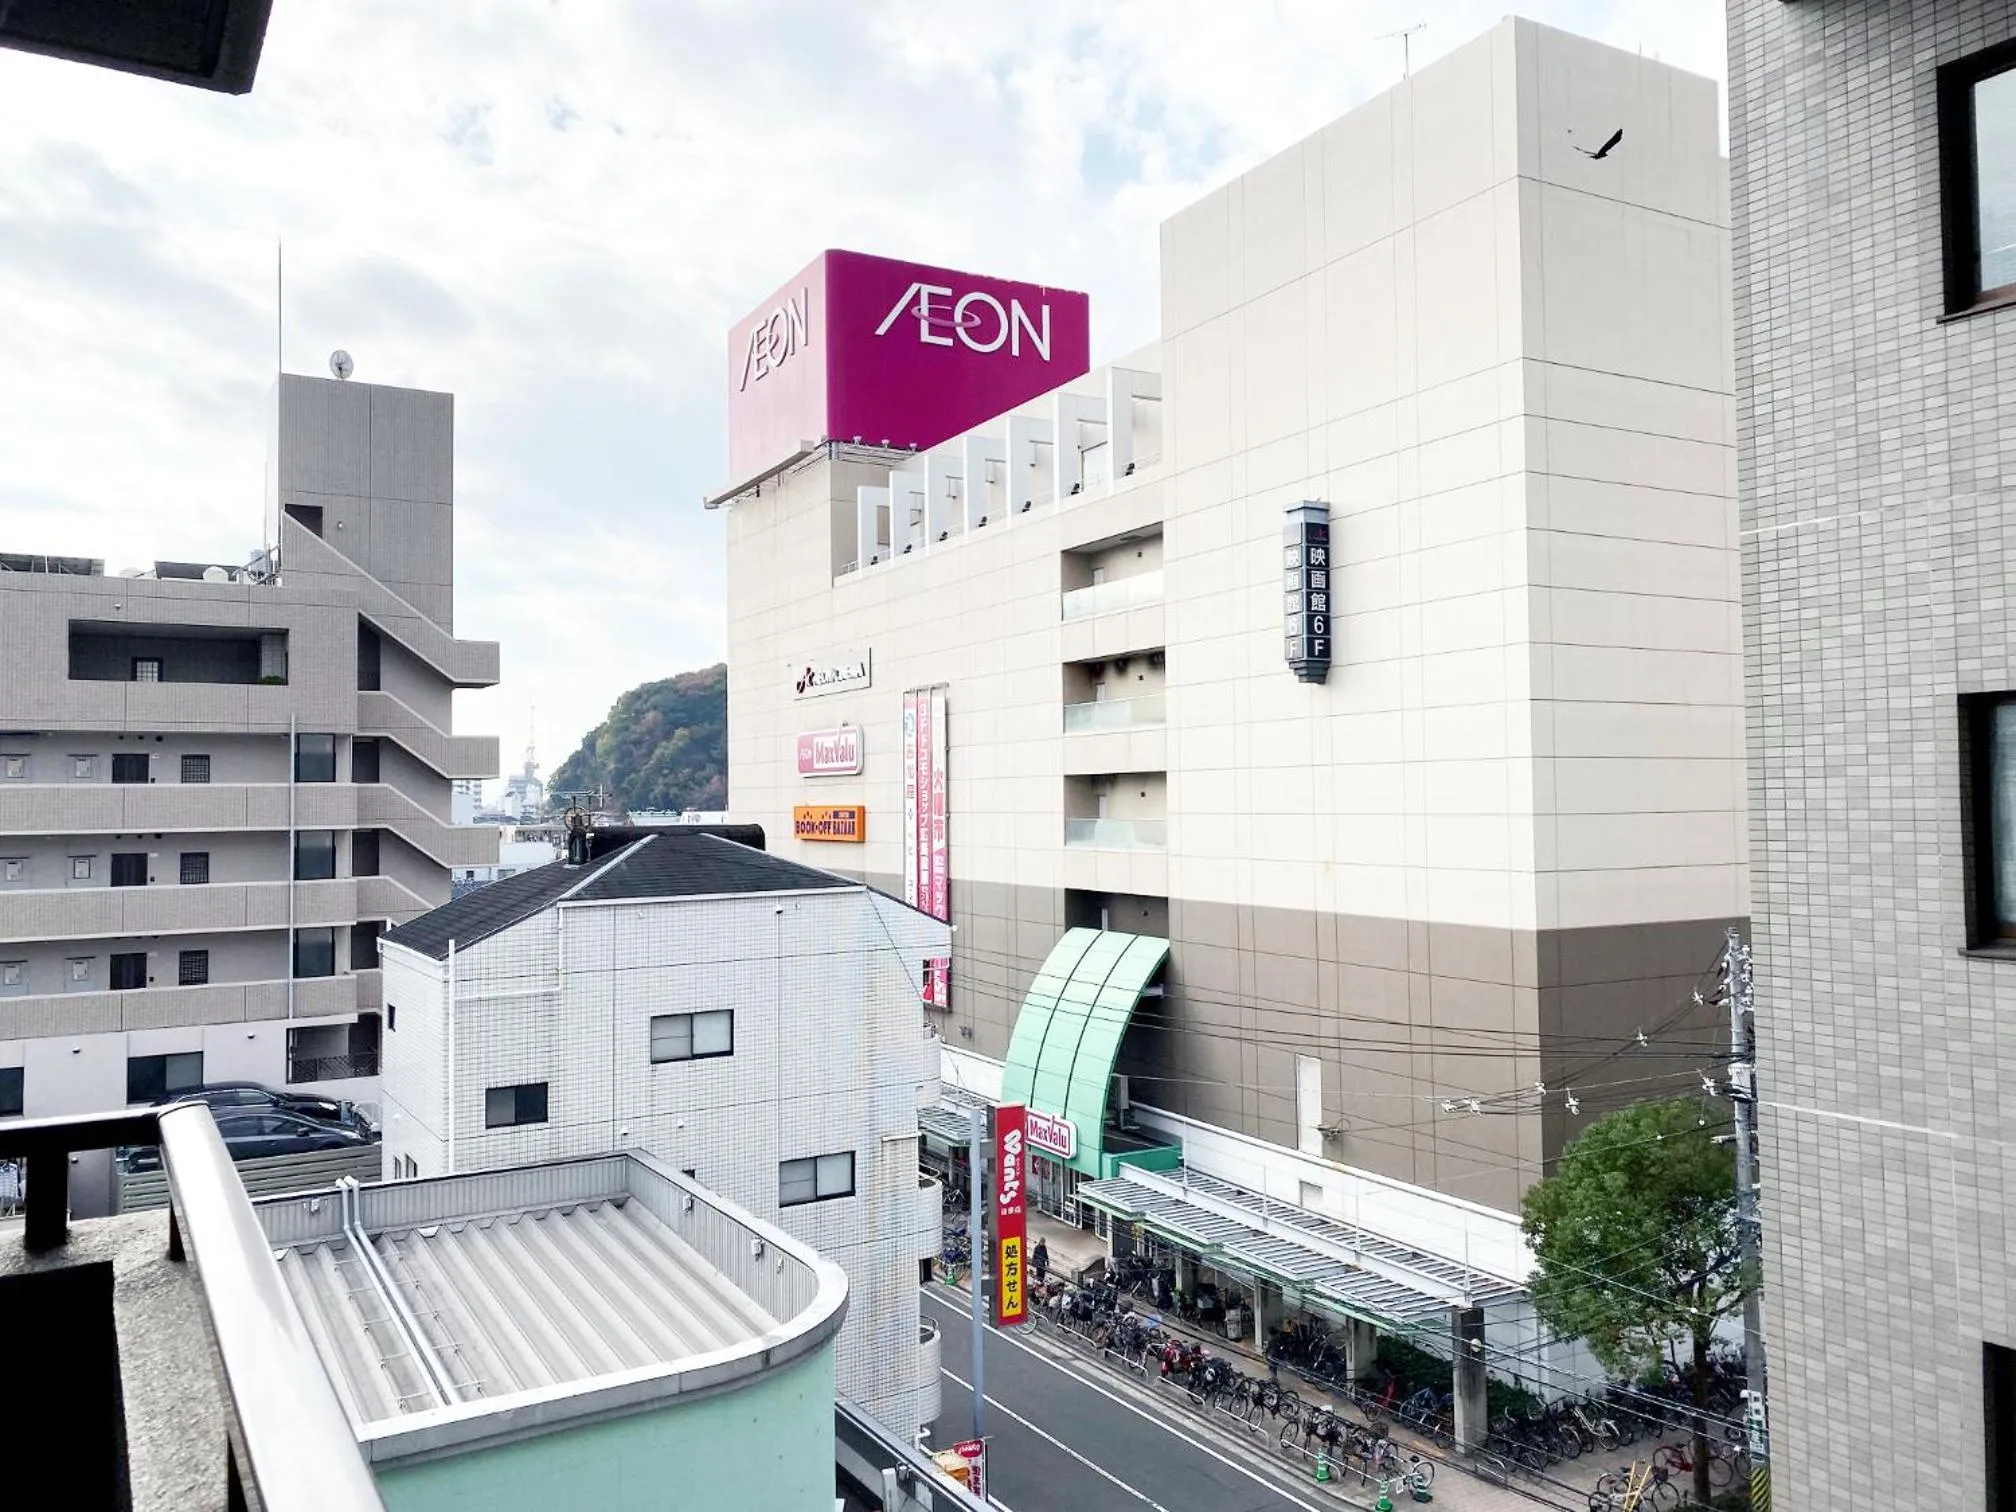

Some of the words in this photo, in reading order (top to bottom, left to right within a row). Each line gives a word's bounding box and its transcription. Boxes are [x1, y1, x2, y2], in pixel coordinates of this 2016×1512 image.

[1309, 547, 1327, 656] 映画館6F
[815, 727, 855, 764] MaxValu
[1029, 1116, 1067, 1150] MaxValu
[999, 1128, 1022, 1205] Wants
[1005, 1244, 1018, 1310] 処方せん
